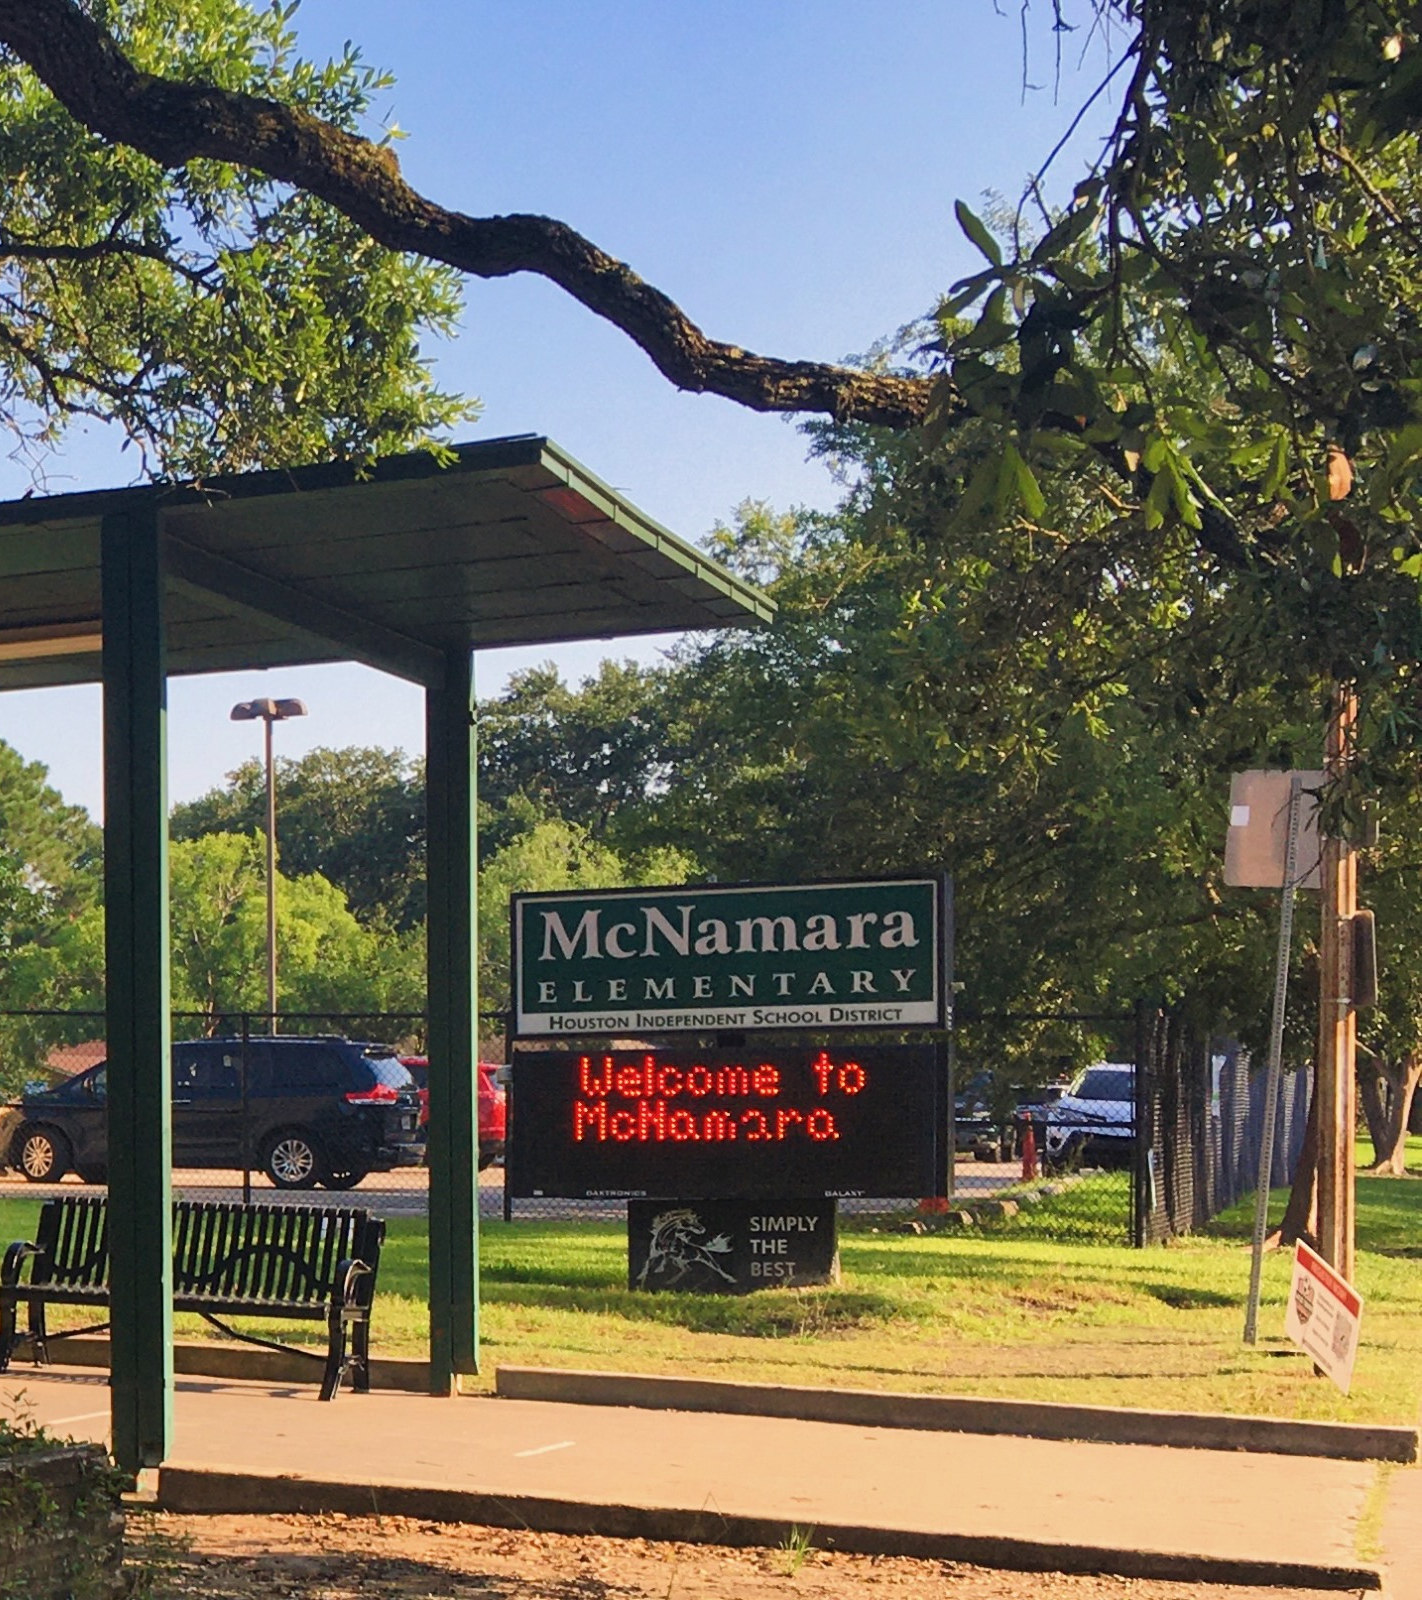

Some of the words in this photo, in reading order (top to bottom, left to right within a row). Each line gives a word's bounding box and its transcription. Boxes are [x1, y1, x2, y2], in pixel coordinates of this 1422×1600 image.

[538, 904, 920, 961] McNamara
[537, 968, 917, 1004] ELEMENTARY
[579, 1055, 781, 1098] Welcome
[813, 1051, 867, 1096] to
[573, 1099, 842, 1143] McNamara
[749, 1216, 819, 1232] SIMPLY
[749, 1239, 788, 1255] THE
[750, 1261, 796, 1277] BEST
